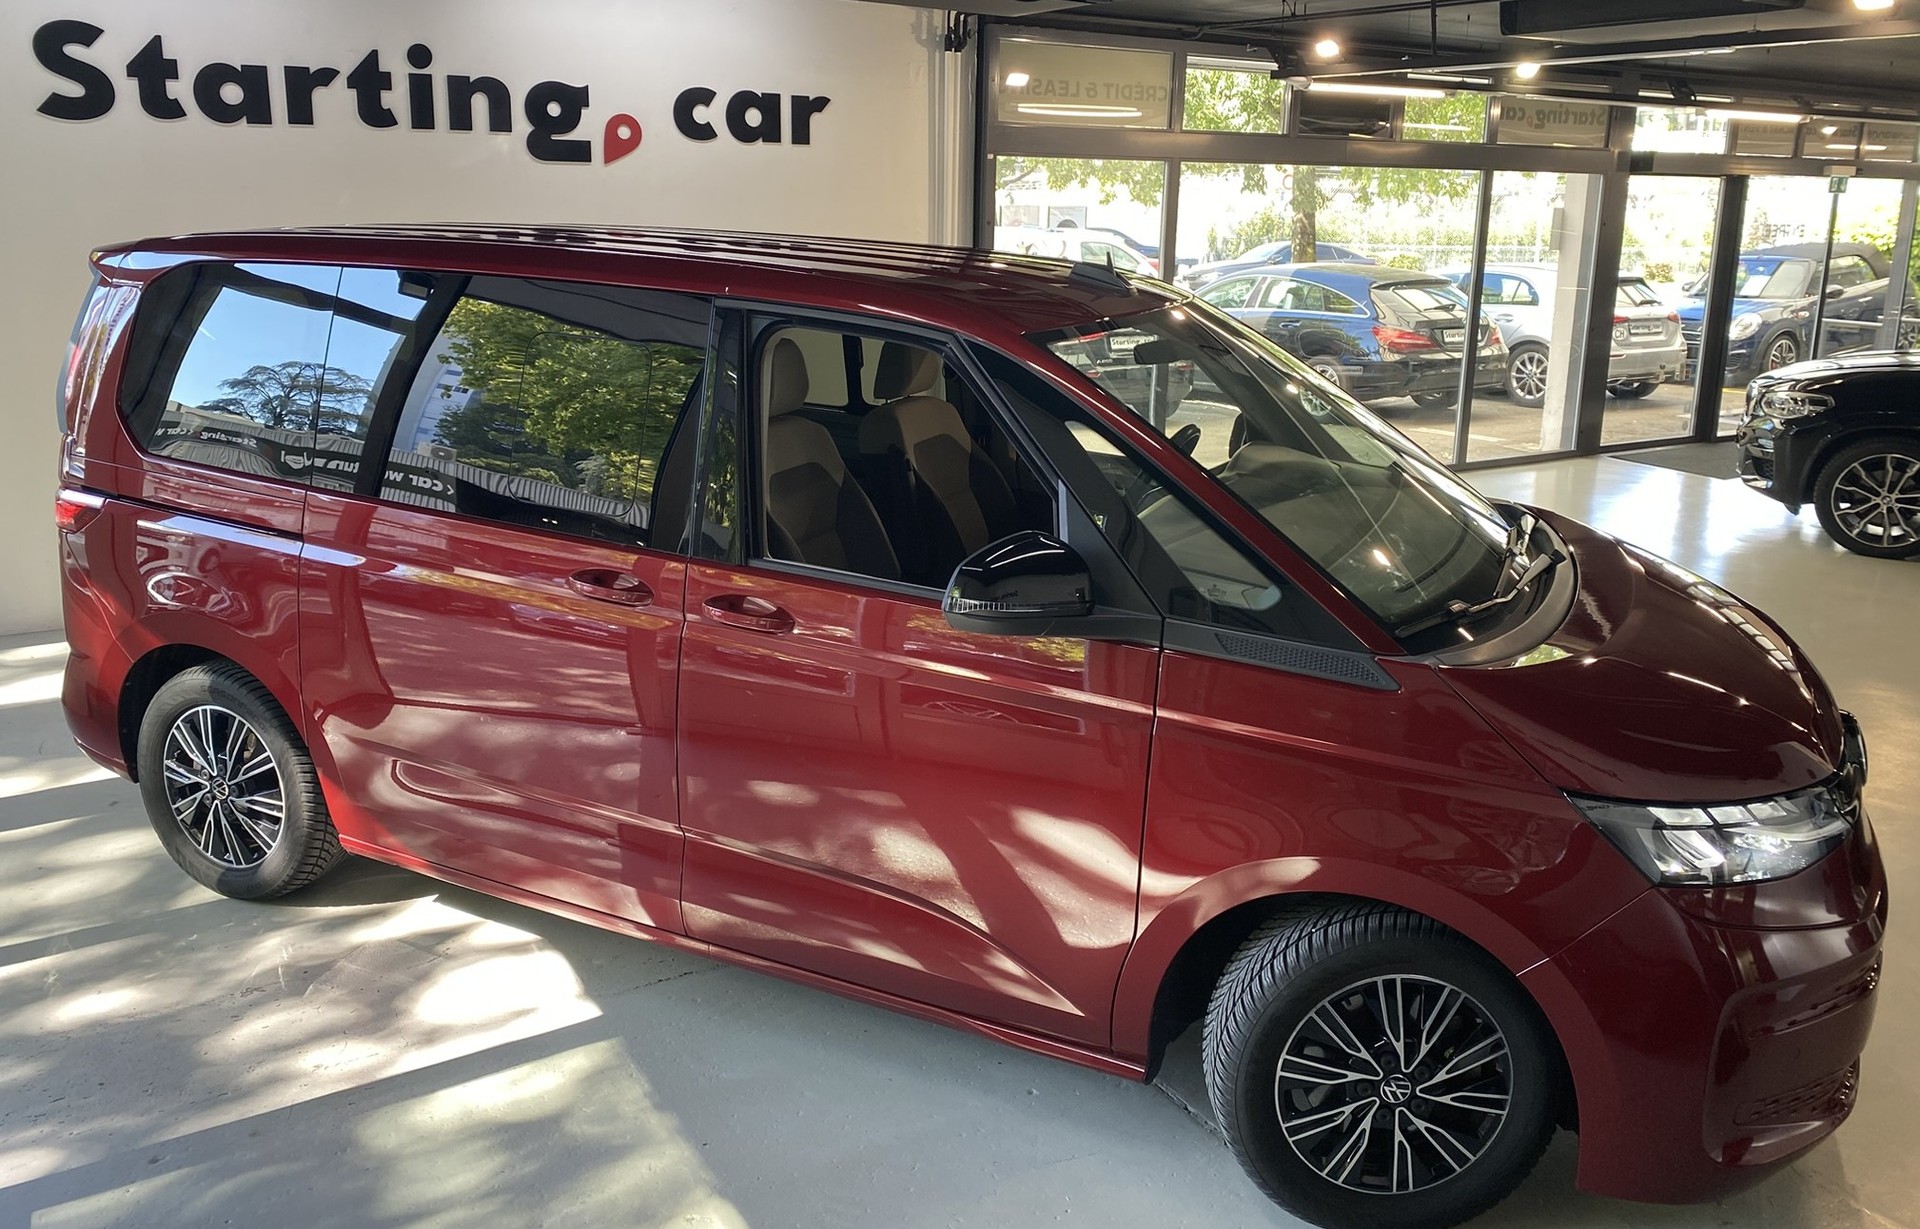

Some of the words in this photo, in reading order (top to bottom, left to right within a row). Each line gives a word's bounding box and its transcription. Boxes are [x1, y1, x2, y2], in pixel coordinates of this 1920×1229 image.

[32, 18, 591, 163] Starting
[673, 86, 831, 146] car
[1444, 330, 1465, 339] Startin
[1614, 330, 1625, 339] CH
